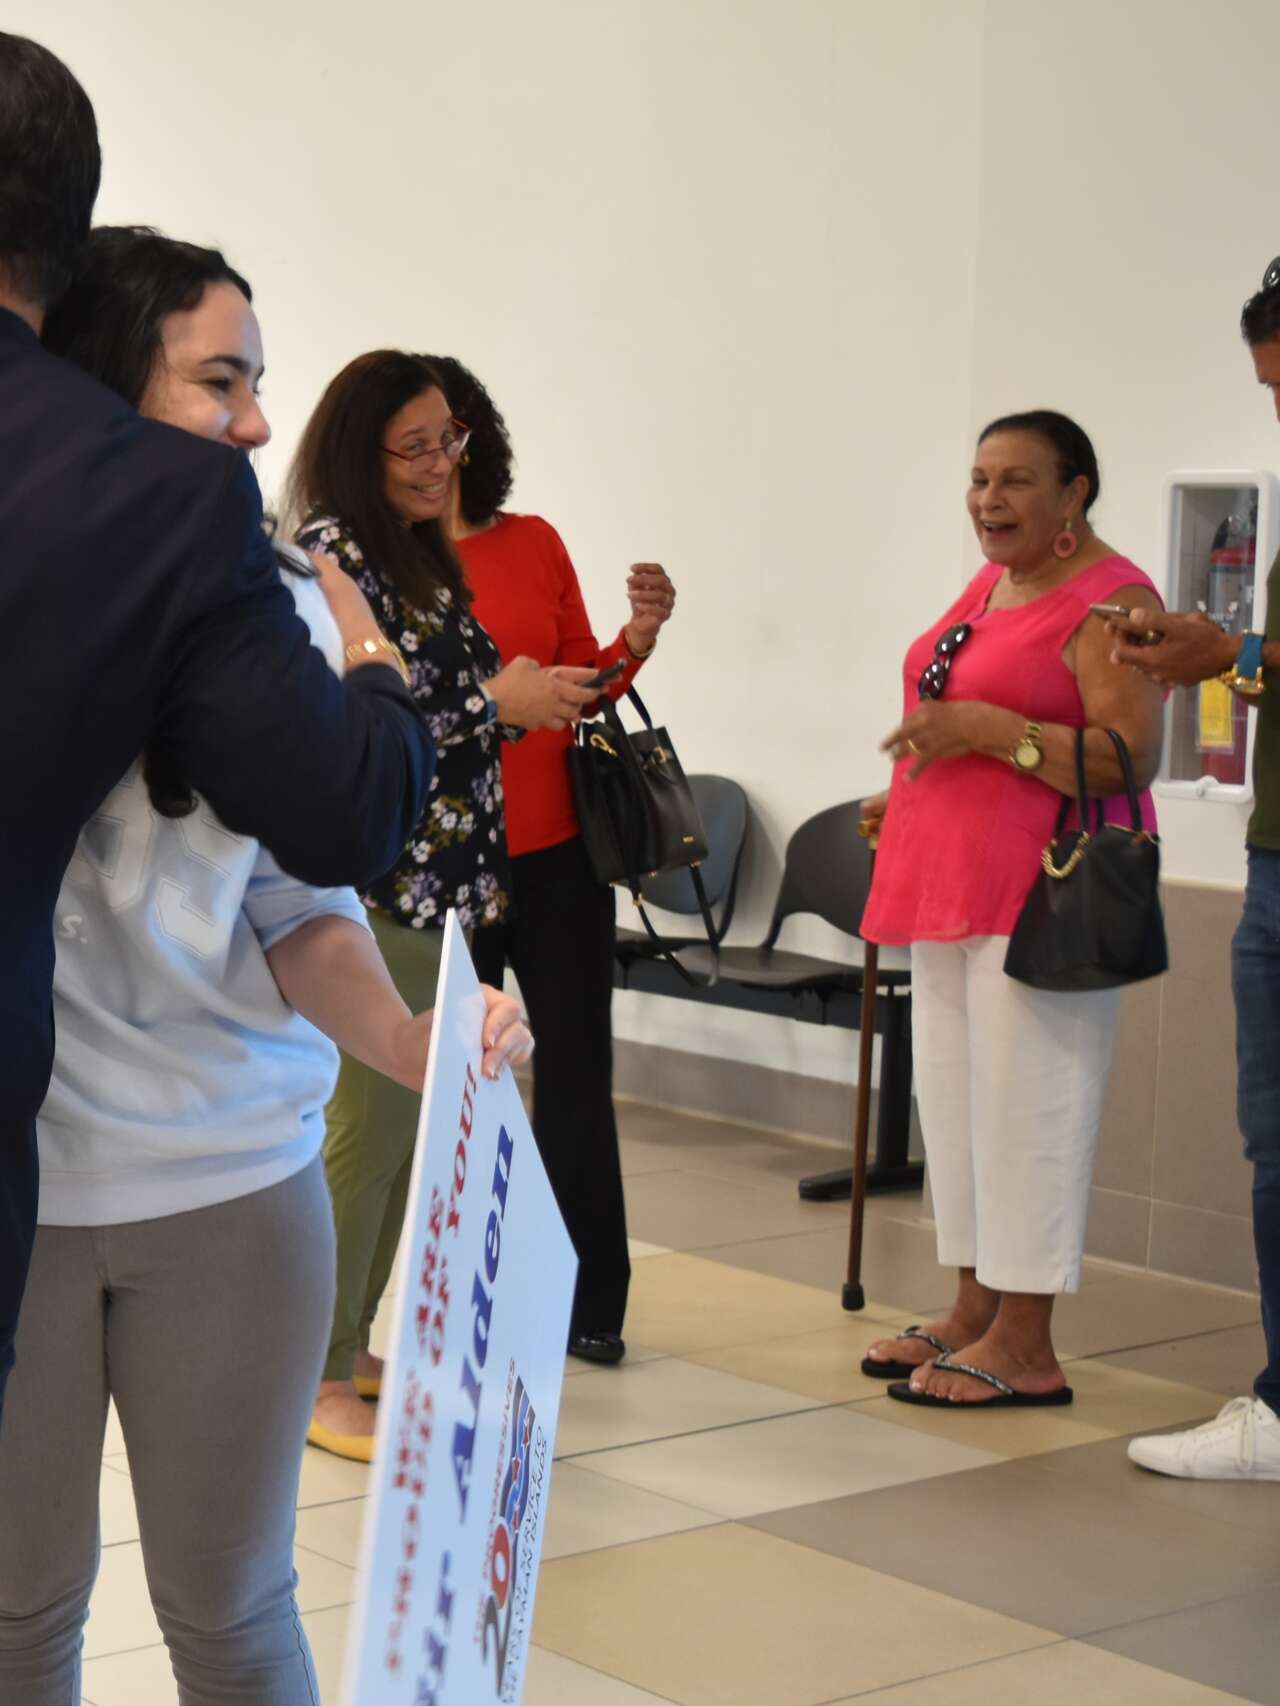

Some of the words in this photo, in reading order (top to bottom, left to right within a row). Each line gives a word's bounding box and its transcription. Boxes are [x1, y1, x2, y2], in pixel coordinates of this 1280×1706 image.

[446, 1062, 476, 1238] YOU!
[452, 1124, 513, 1524] Alden
[529, 1438, 547, 1541] ISLANDS
[481, 1523, 510, 1697] 20
